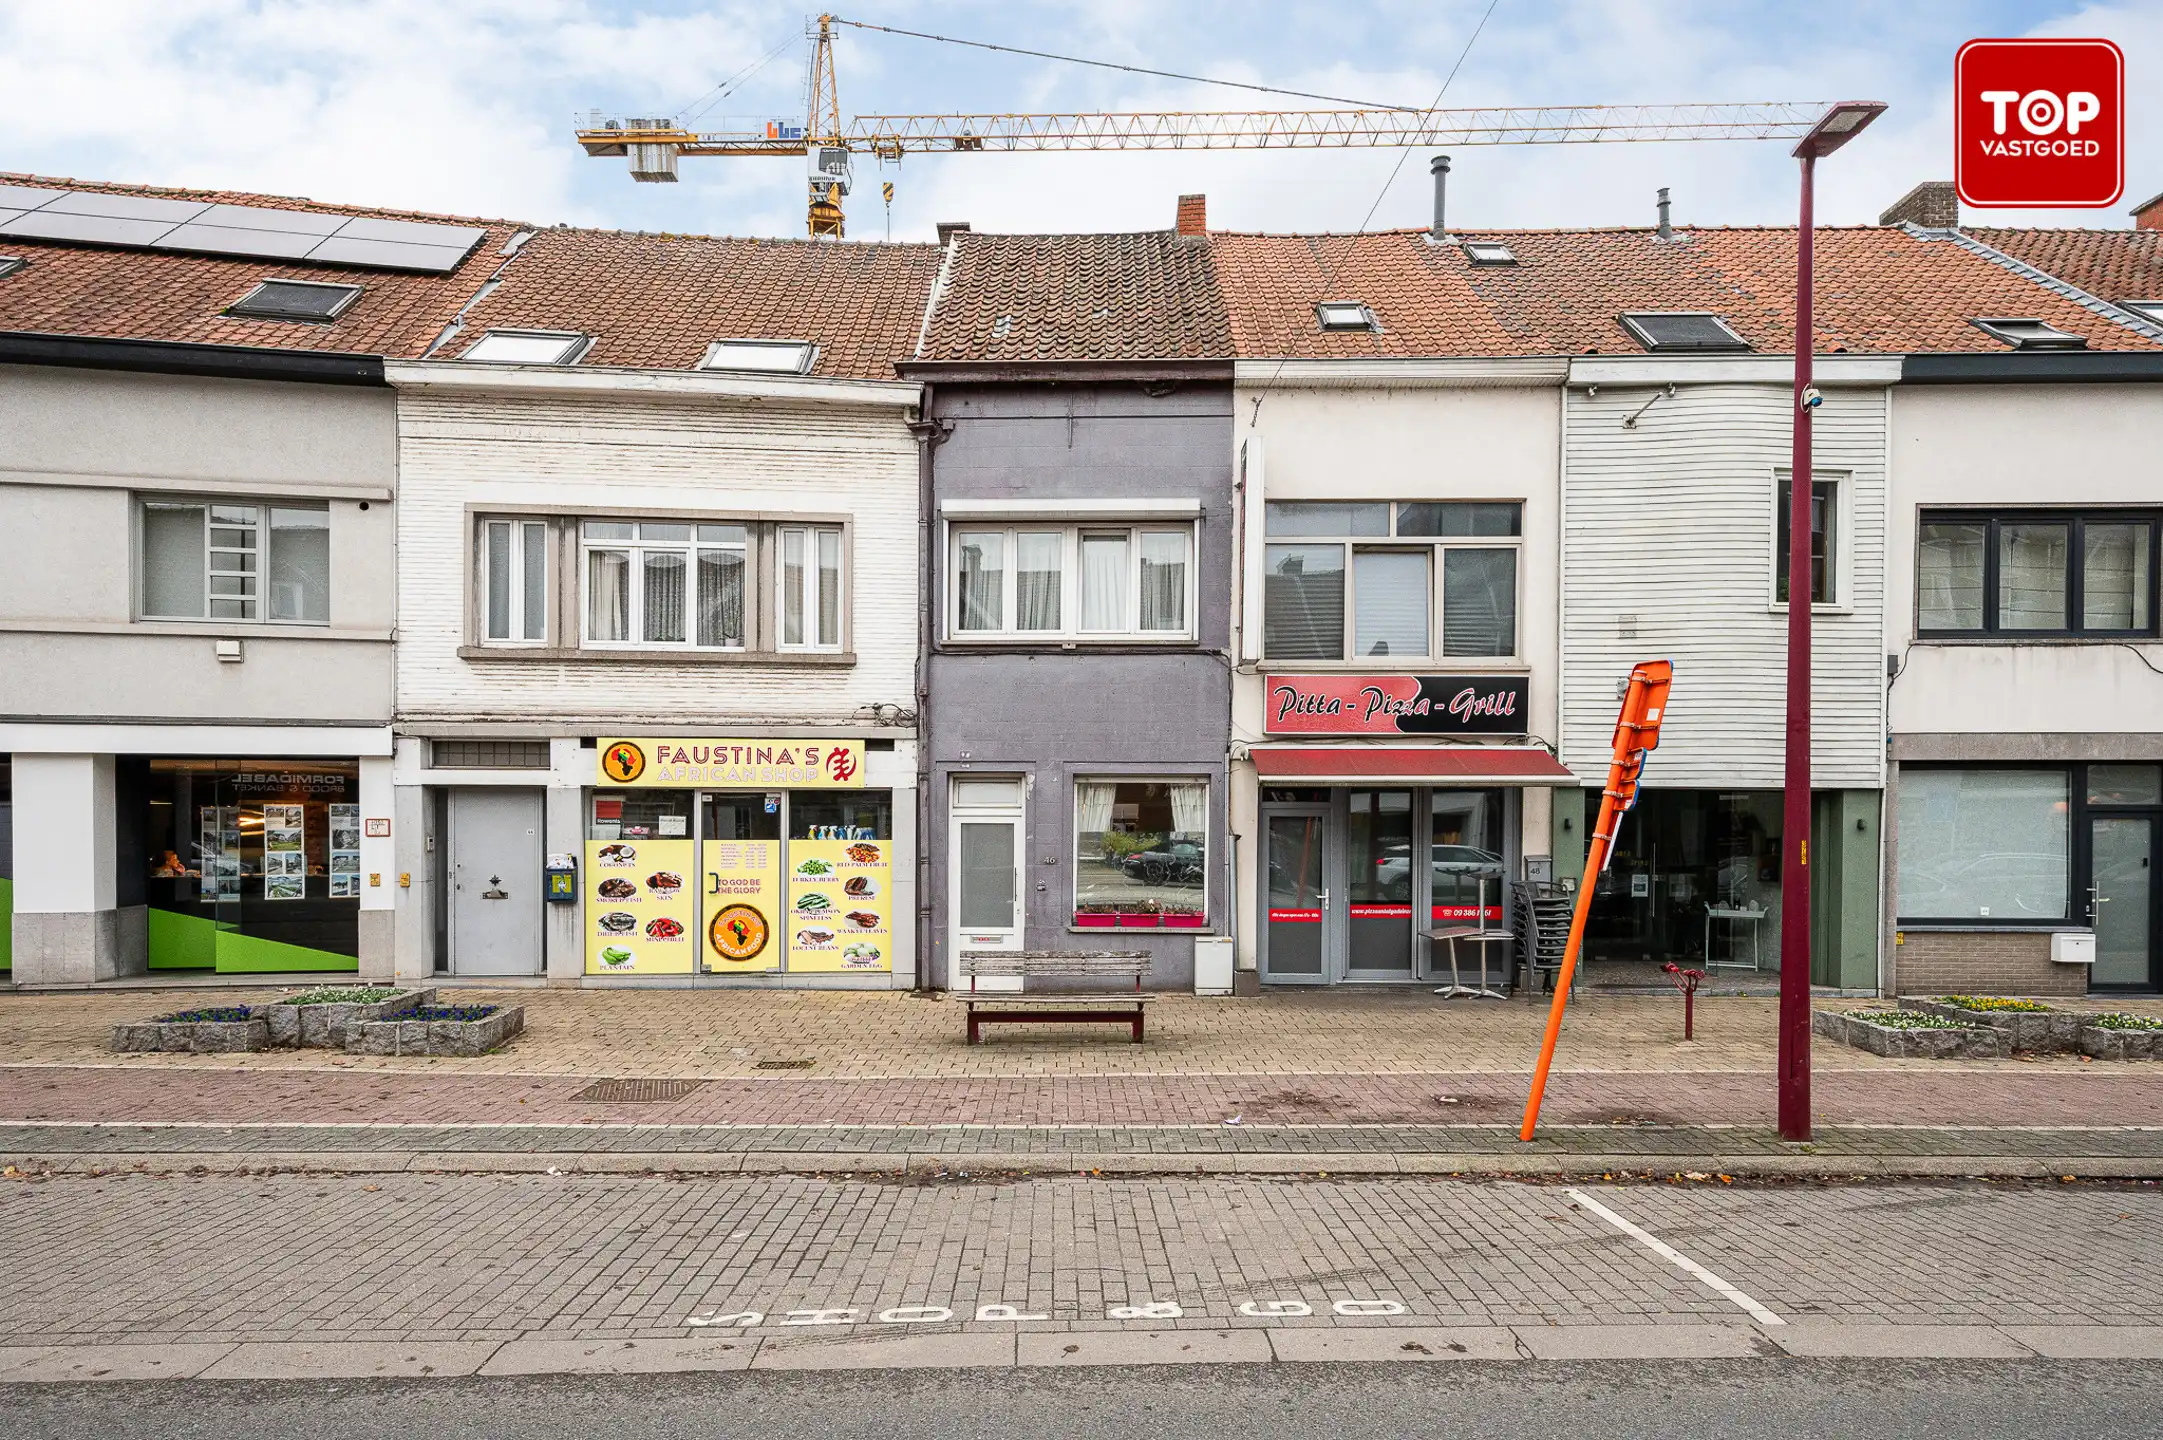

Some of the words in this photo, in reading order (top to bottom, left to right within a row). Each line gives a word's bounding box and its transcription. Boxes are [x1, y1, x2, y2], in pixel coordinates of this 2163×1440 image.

[1274, 686, 1340, 722] Pitta
[1346, 702, 1356, 710] -
[1360, 686, 1430, 722] Pizza
[1449, 687, 1516, 723] Grill
[657, 745, 820, 765] FAUSTINA'S
[657, 766, 757, 782] AFRICAN
[761, 767, 818, 782] SHOP
[1043, 856, 1056, 864] 46
[1530, 867, 1541, 875] 48
[716, 933, 747, 955] AFRICAN
[746, 932, 763, 952] FOOD
[688, 1304, 1049, 1326] SHOP
[1239, 1300, 1406, 1316] GO
